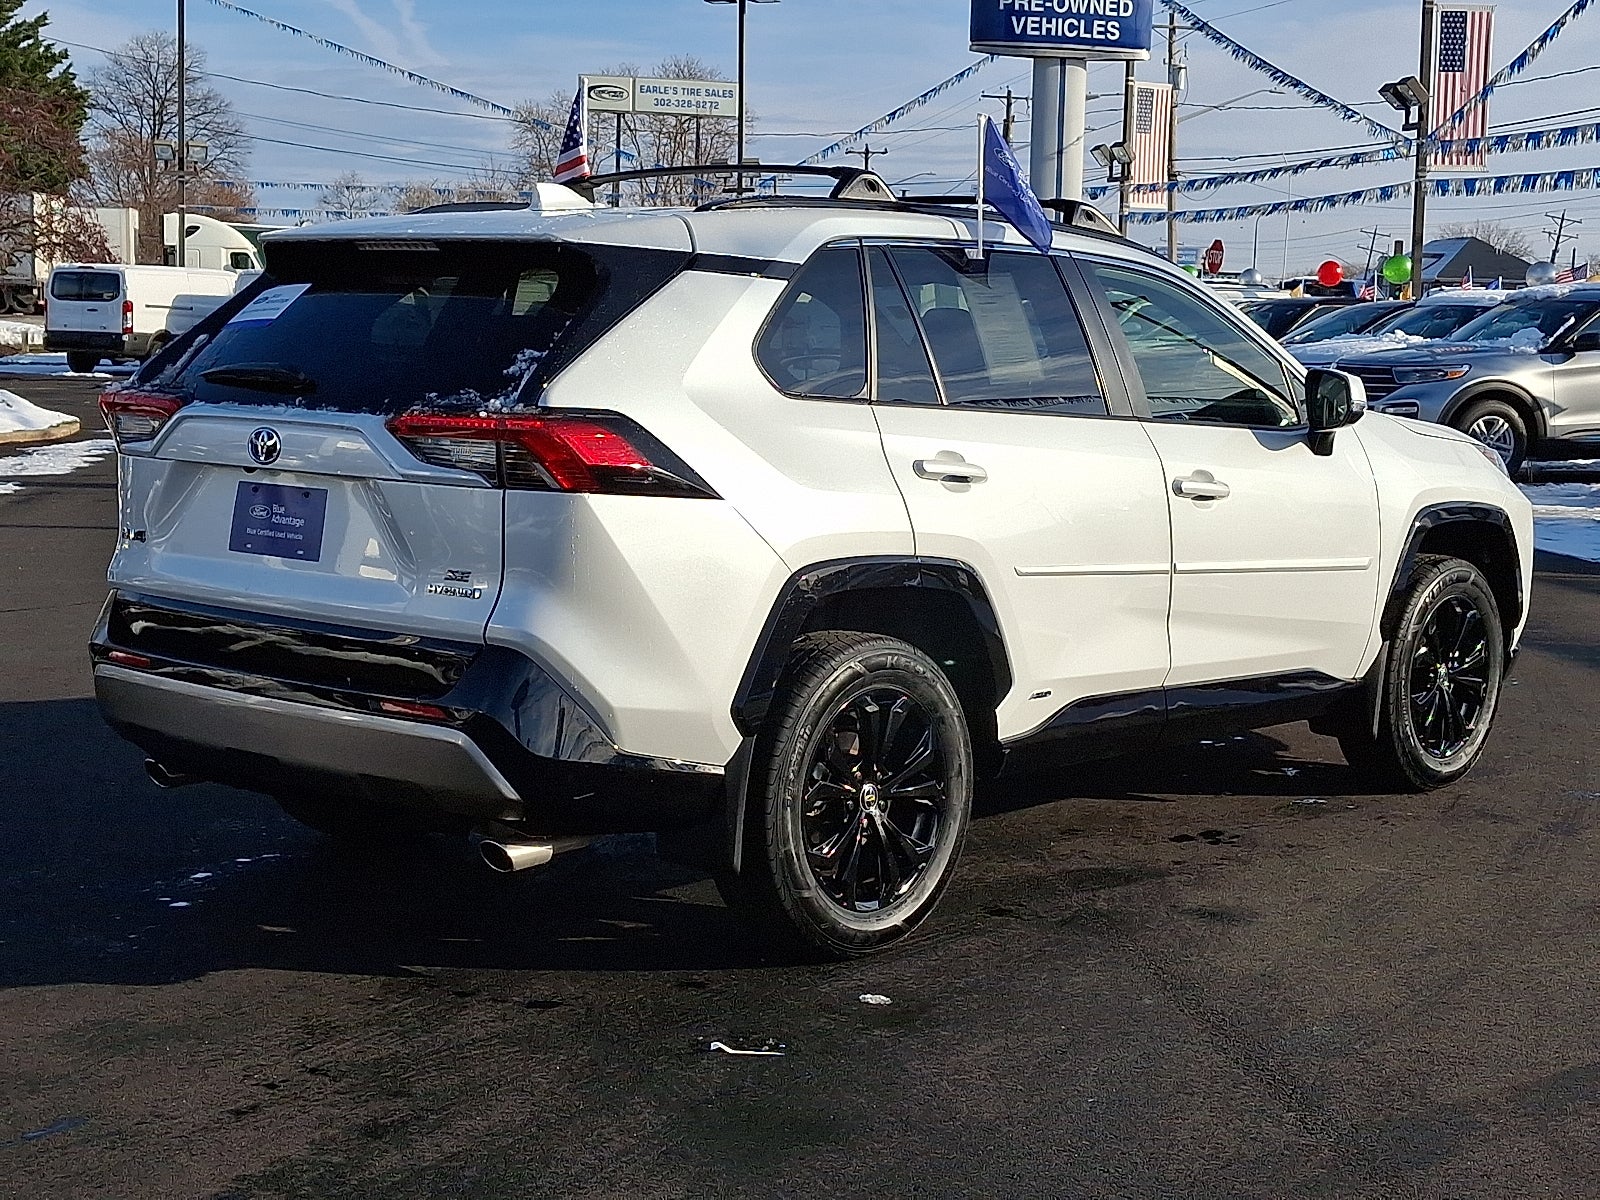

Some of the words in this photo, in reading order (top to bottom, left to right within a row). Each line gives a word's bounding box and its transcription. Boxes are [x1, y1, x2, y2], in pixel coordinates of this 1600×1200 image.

[998, 0, 1134, 17] PRE-OWNED
[1011, 16, 1121, 41] VEHICLES
[639, 84, 678, 96] EARLE'S
[681, 87, 702, 97] TIRE
[704, 88, 734, 99] SALES
[1208, 249, 1223, 264] STOP
[271, 513, 305, 528] Advantage
